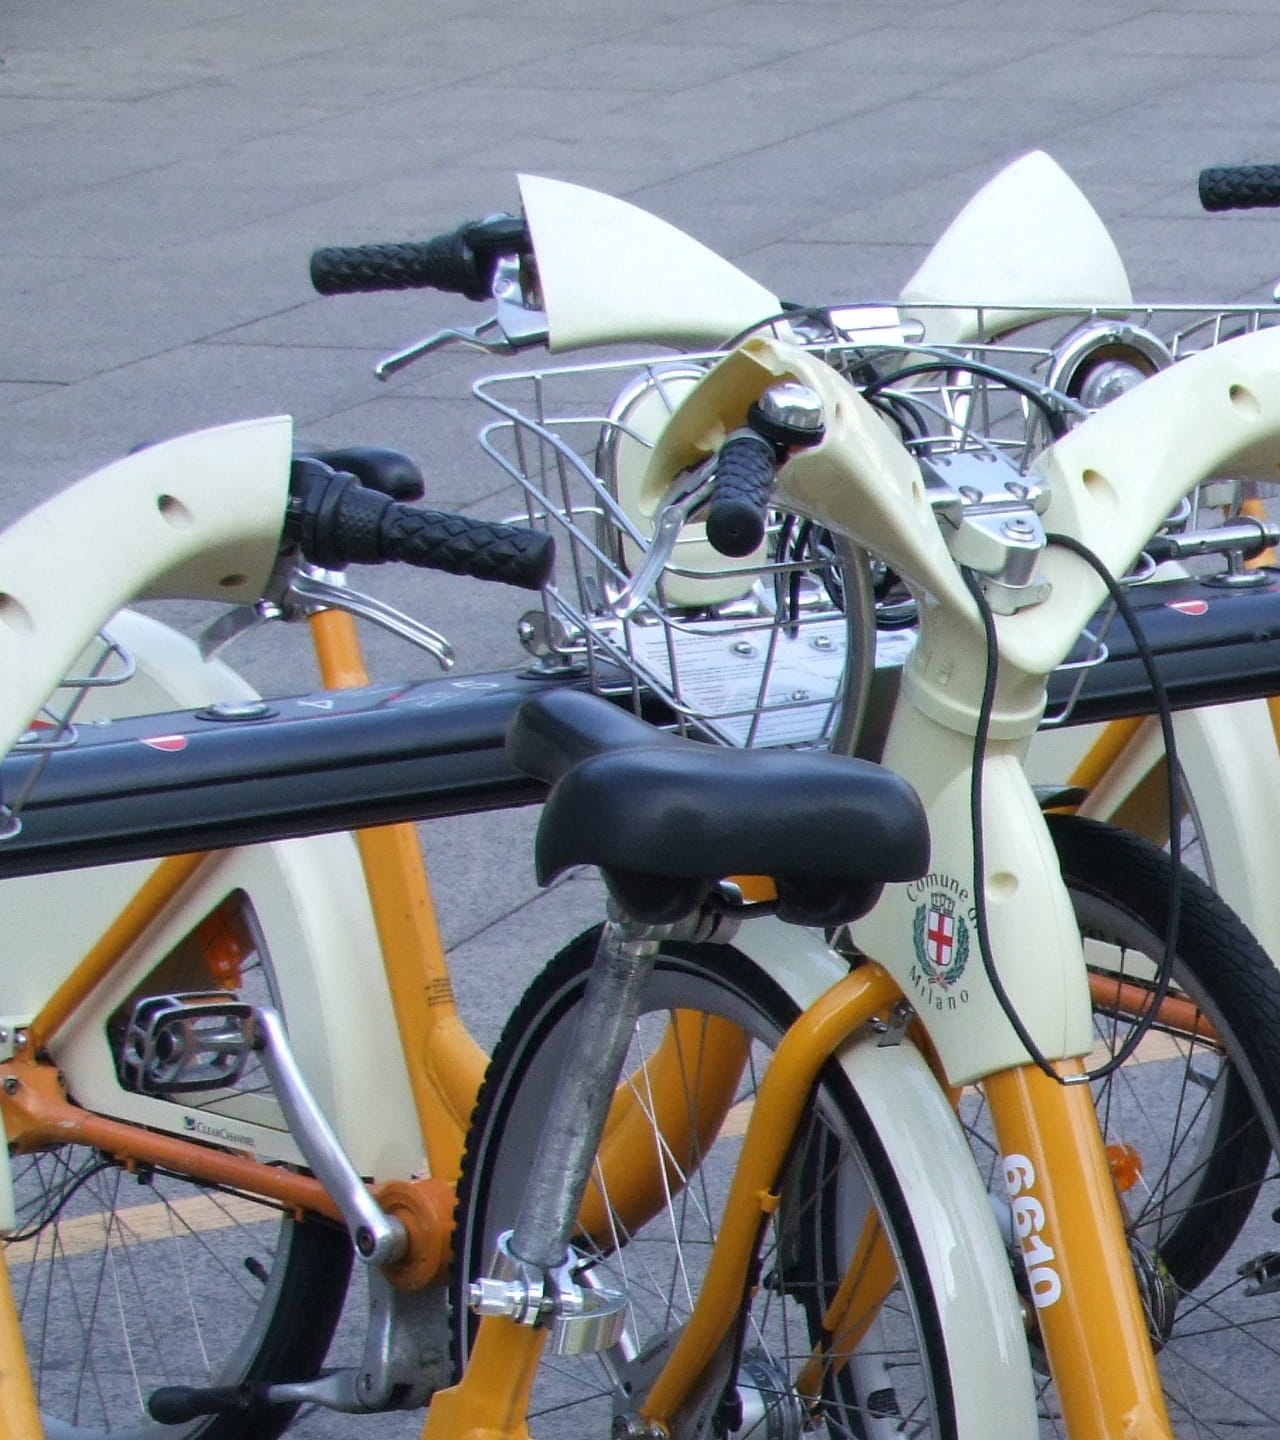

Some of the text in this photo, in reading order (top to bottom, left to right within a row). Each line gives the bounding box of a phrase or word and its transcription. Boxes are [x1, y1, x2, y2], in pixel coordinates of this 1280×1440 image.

[906, 873, 969, 903] Comune
[909, 965, 969, 1011] Milano
[1003, 1153, 1062, 1309] 6610
